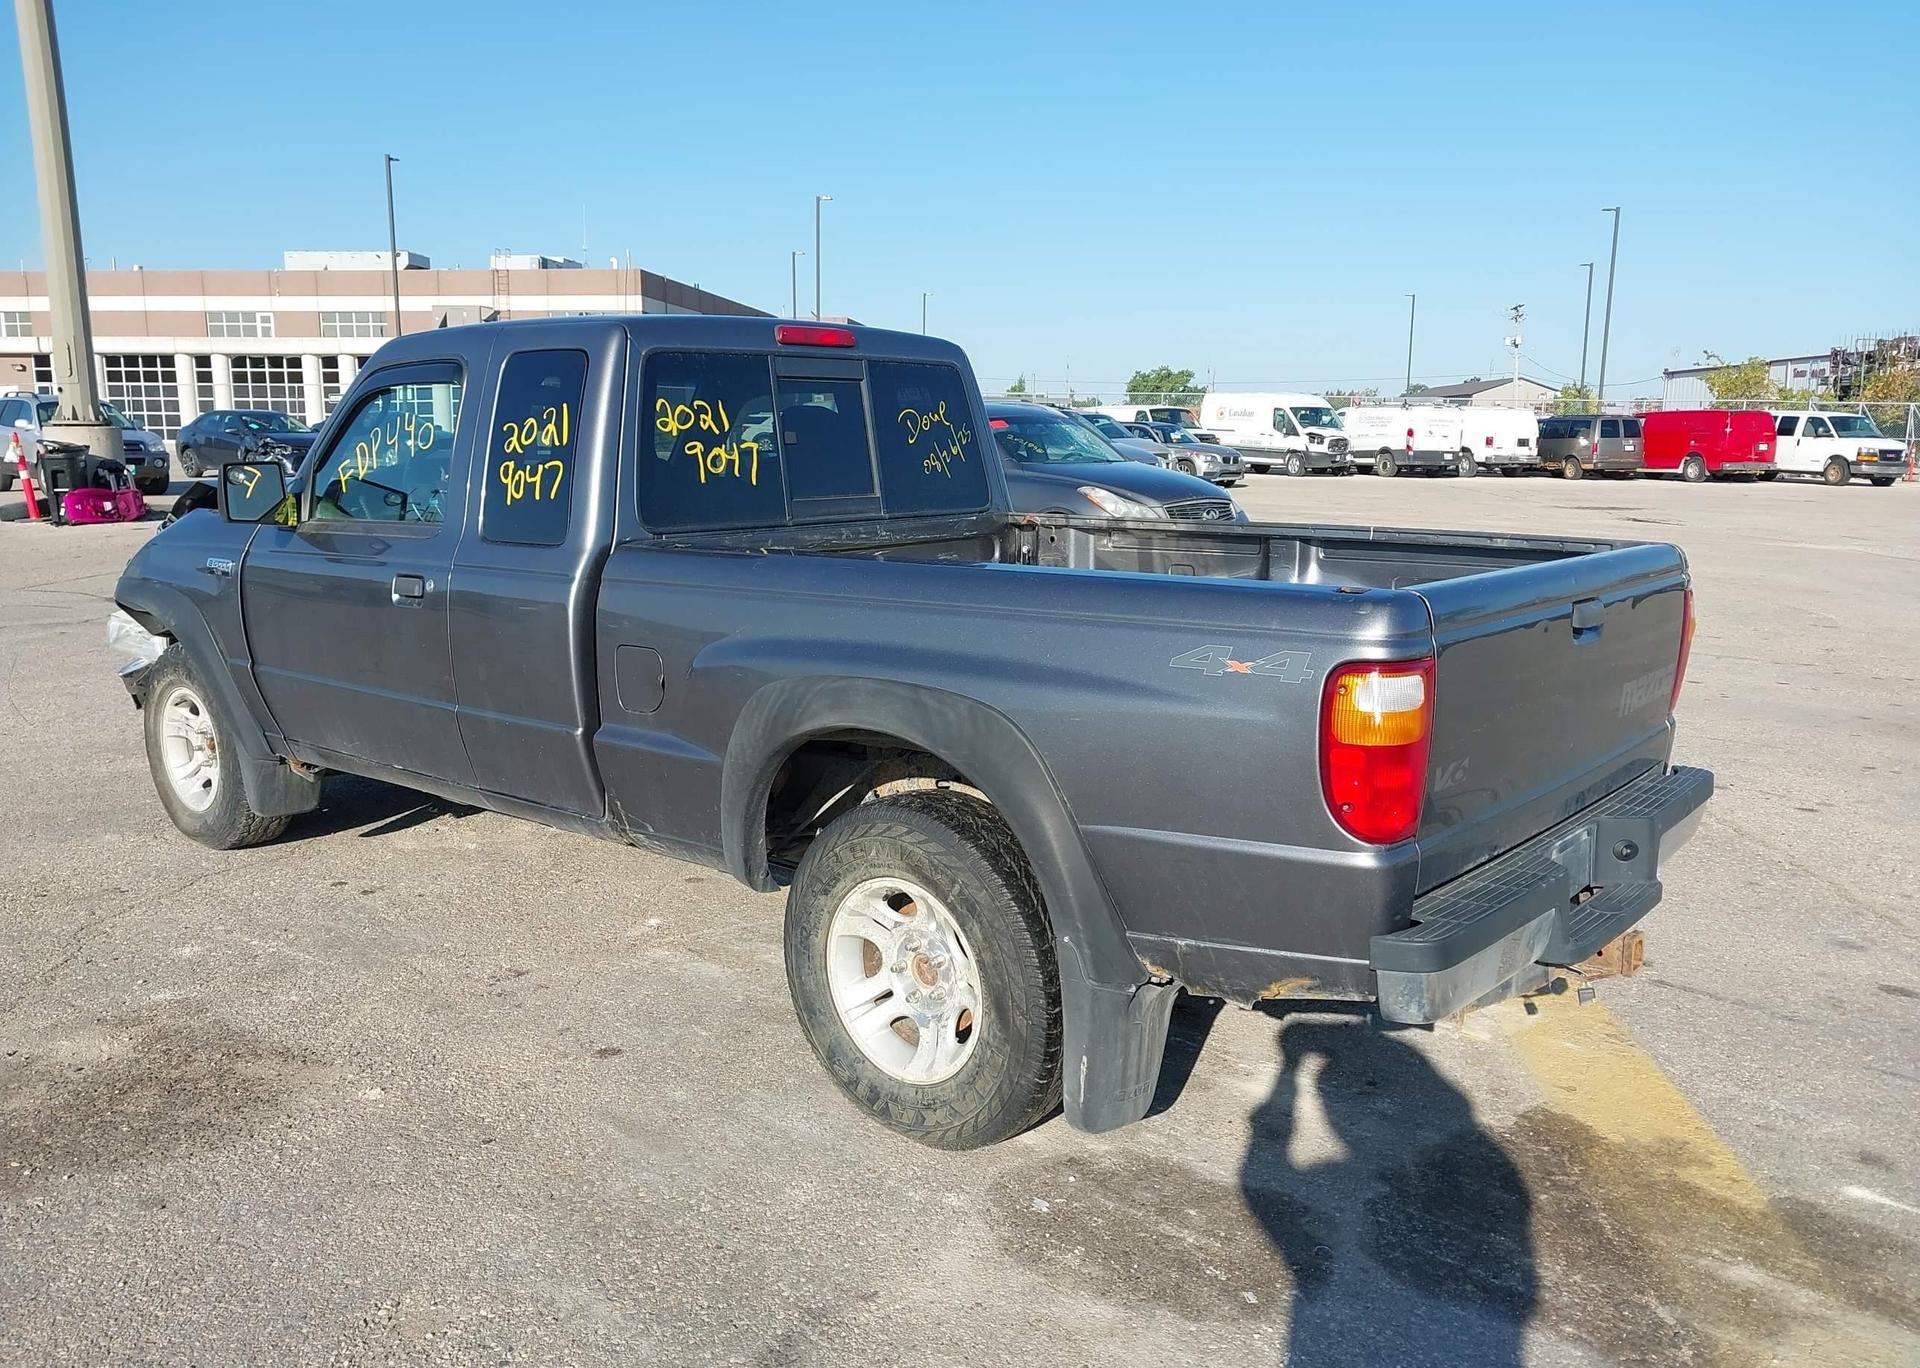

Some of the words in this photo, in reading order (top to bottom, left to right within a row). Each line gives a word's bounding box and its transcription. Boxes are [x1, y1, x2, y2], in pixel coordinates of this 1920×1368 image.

[502, 403, 569, 454] 2021
[655, 398, 730, 437] 2021
[499, 459, 565, 505] 9047
[684, 441, 760, 486] 9047
